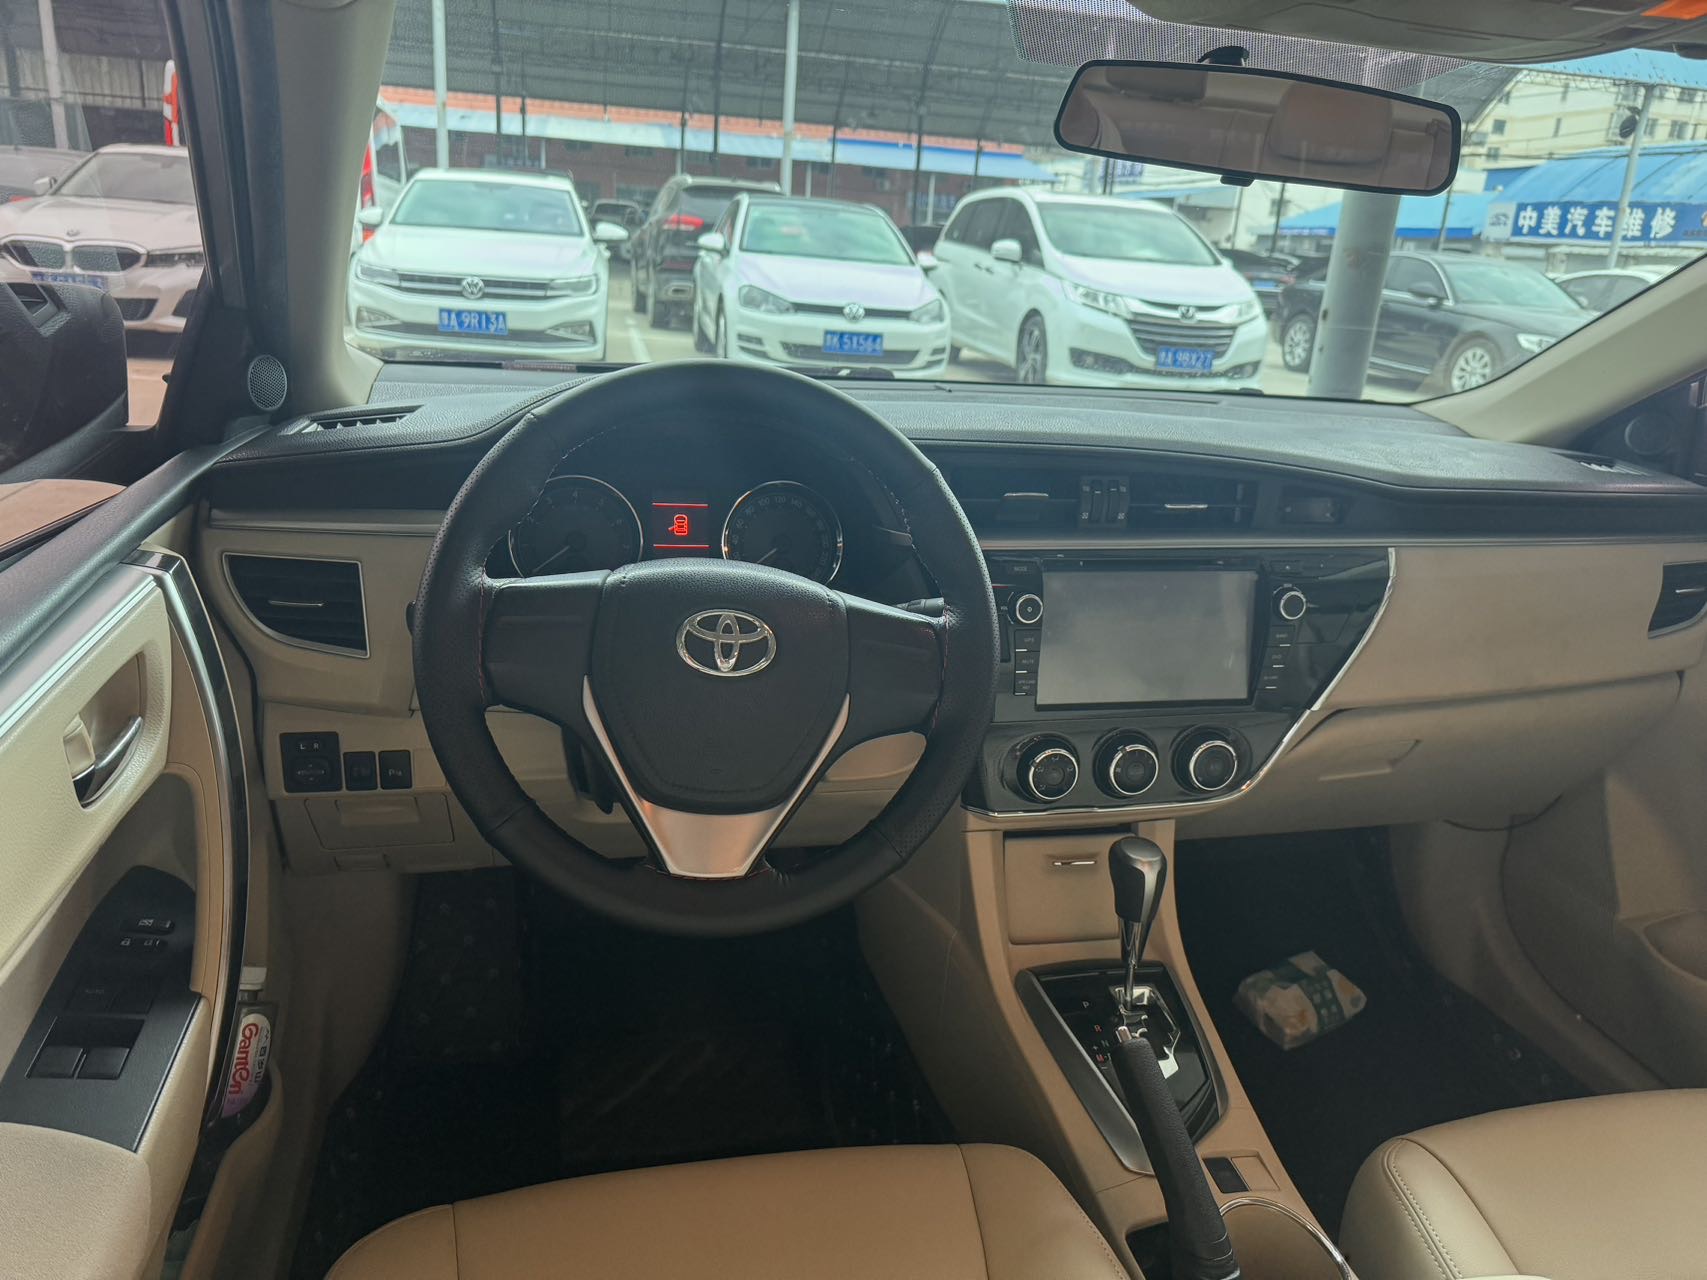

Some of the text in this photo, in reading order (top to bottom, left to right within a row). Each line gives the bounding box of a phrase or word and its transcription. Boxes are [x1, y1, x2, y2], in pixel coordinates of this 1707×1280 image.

[1517, 204, 1677, 239] 中美汽车维修
